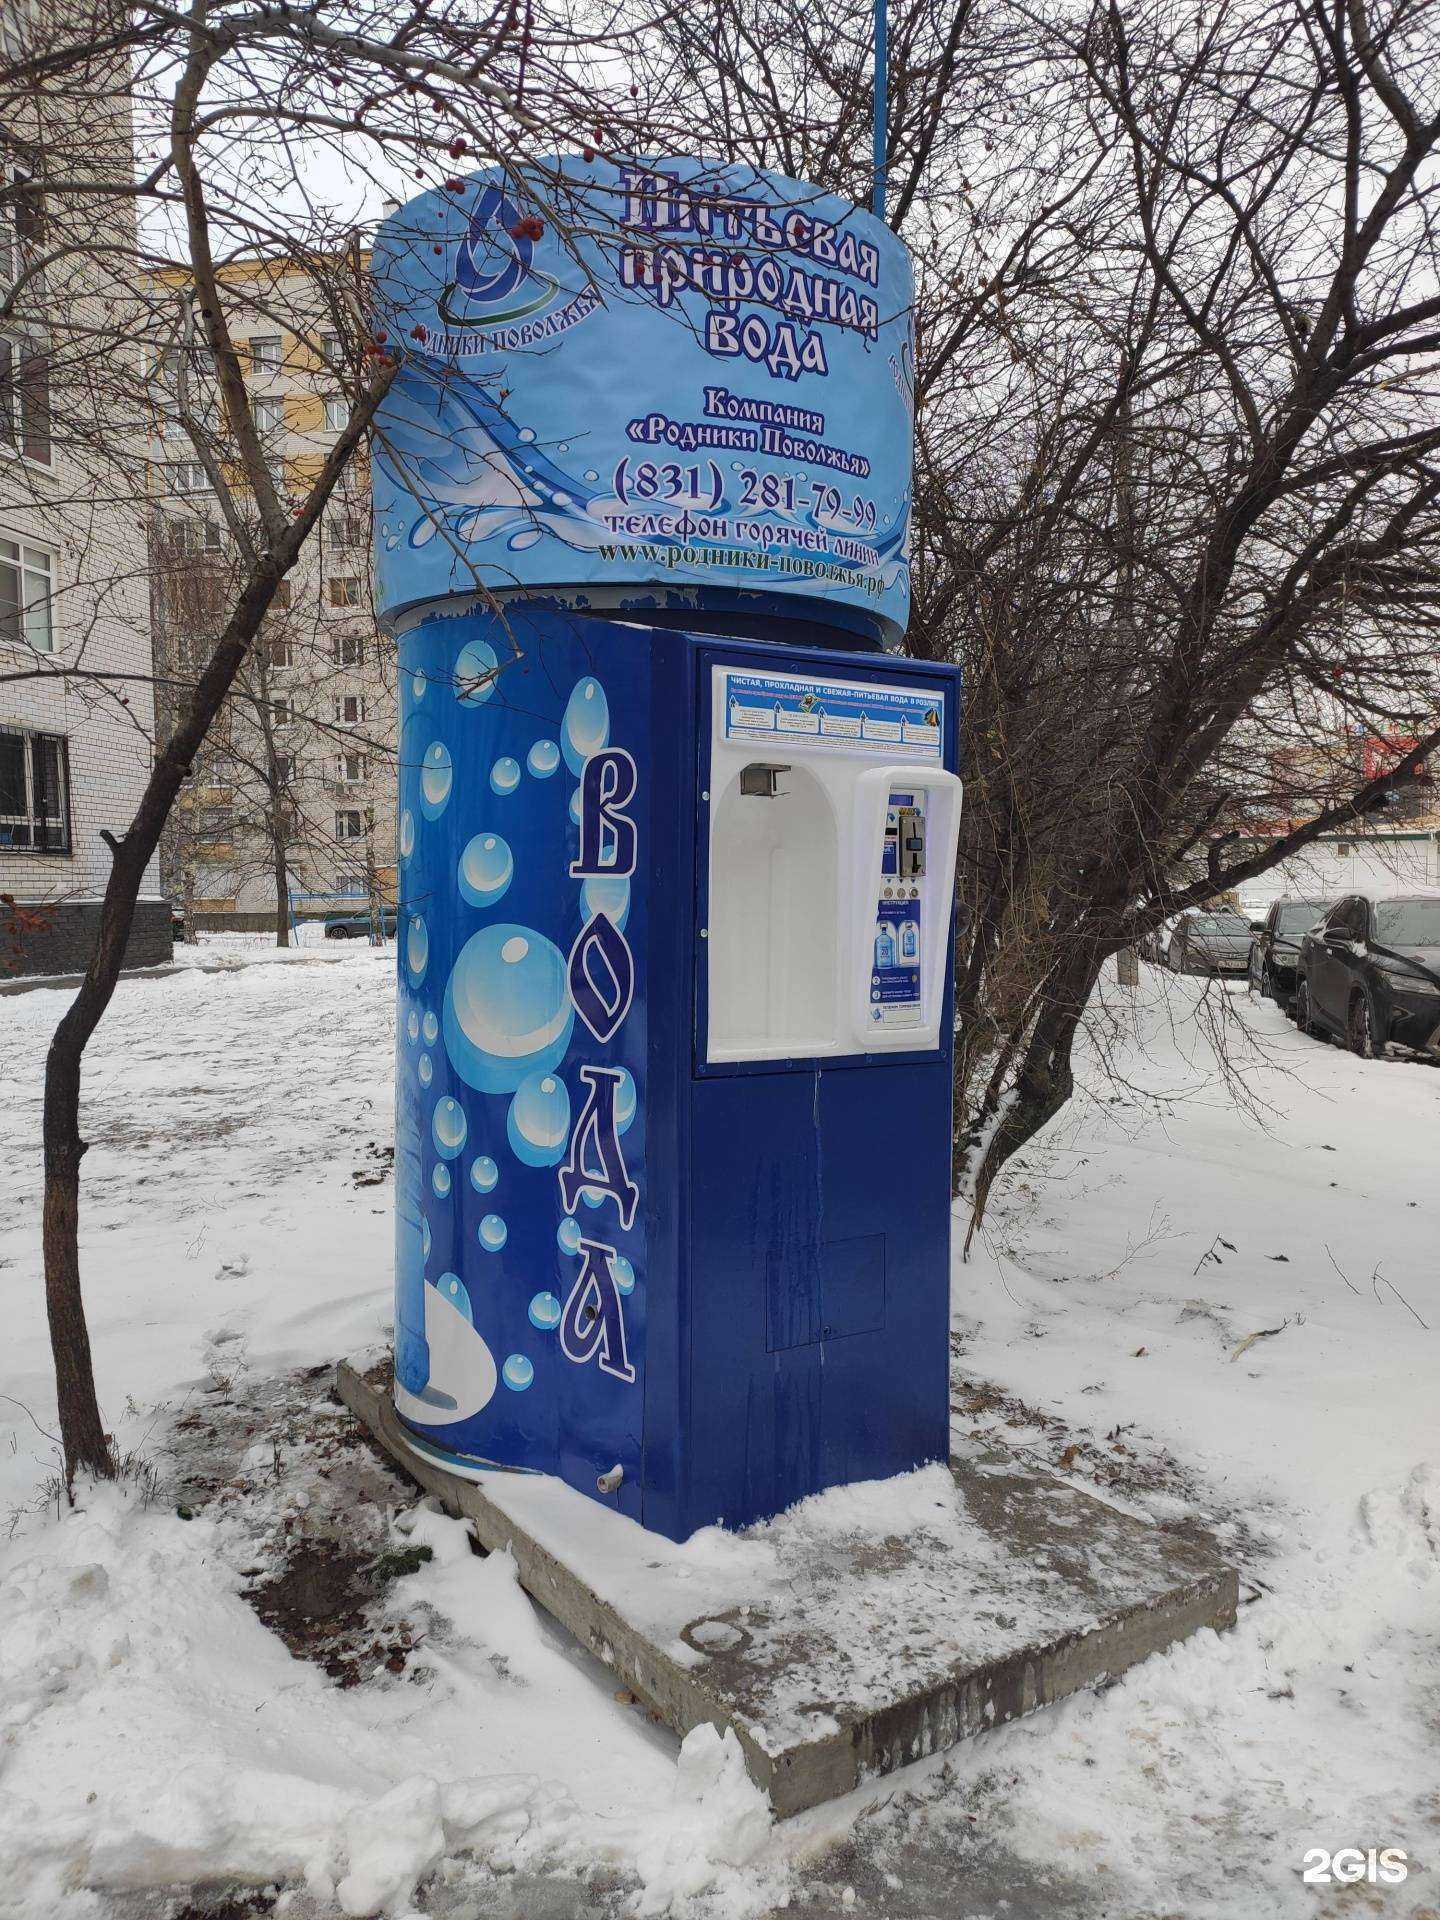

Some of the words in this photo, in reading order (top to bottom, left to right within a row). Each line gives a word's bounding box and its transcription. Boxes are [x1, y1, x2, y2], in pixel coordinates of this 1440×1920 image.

[704, 386, 825, 436] Компания
[625, 413, 758, 451] «Родники
[760, 424, 871, 479] Поволжья»
[613, 455, 724, 509] (831)
[738, 470, 878, 532] 281-79-99
[735, 521, 829, 552] горячей
[834, 538, 880, 568] линии
